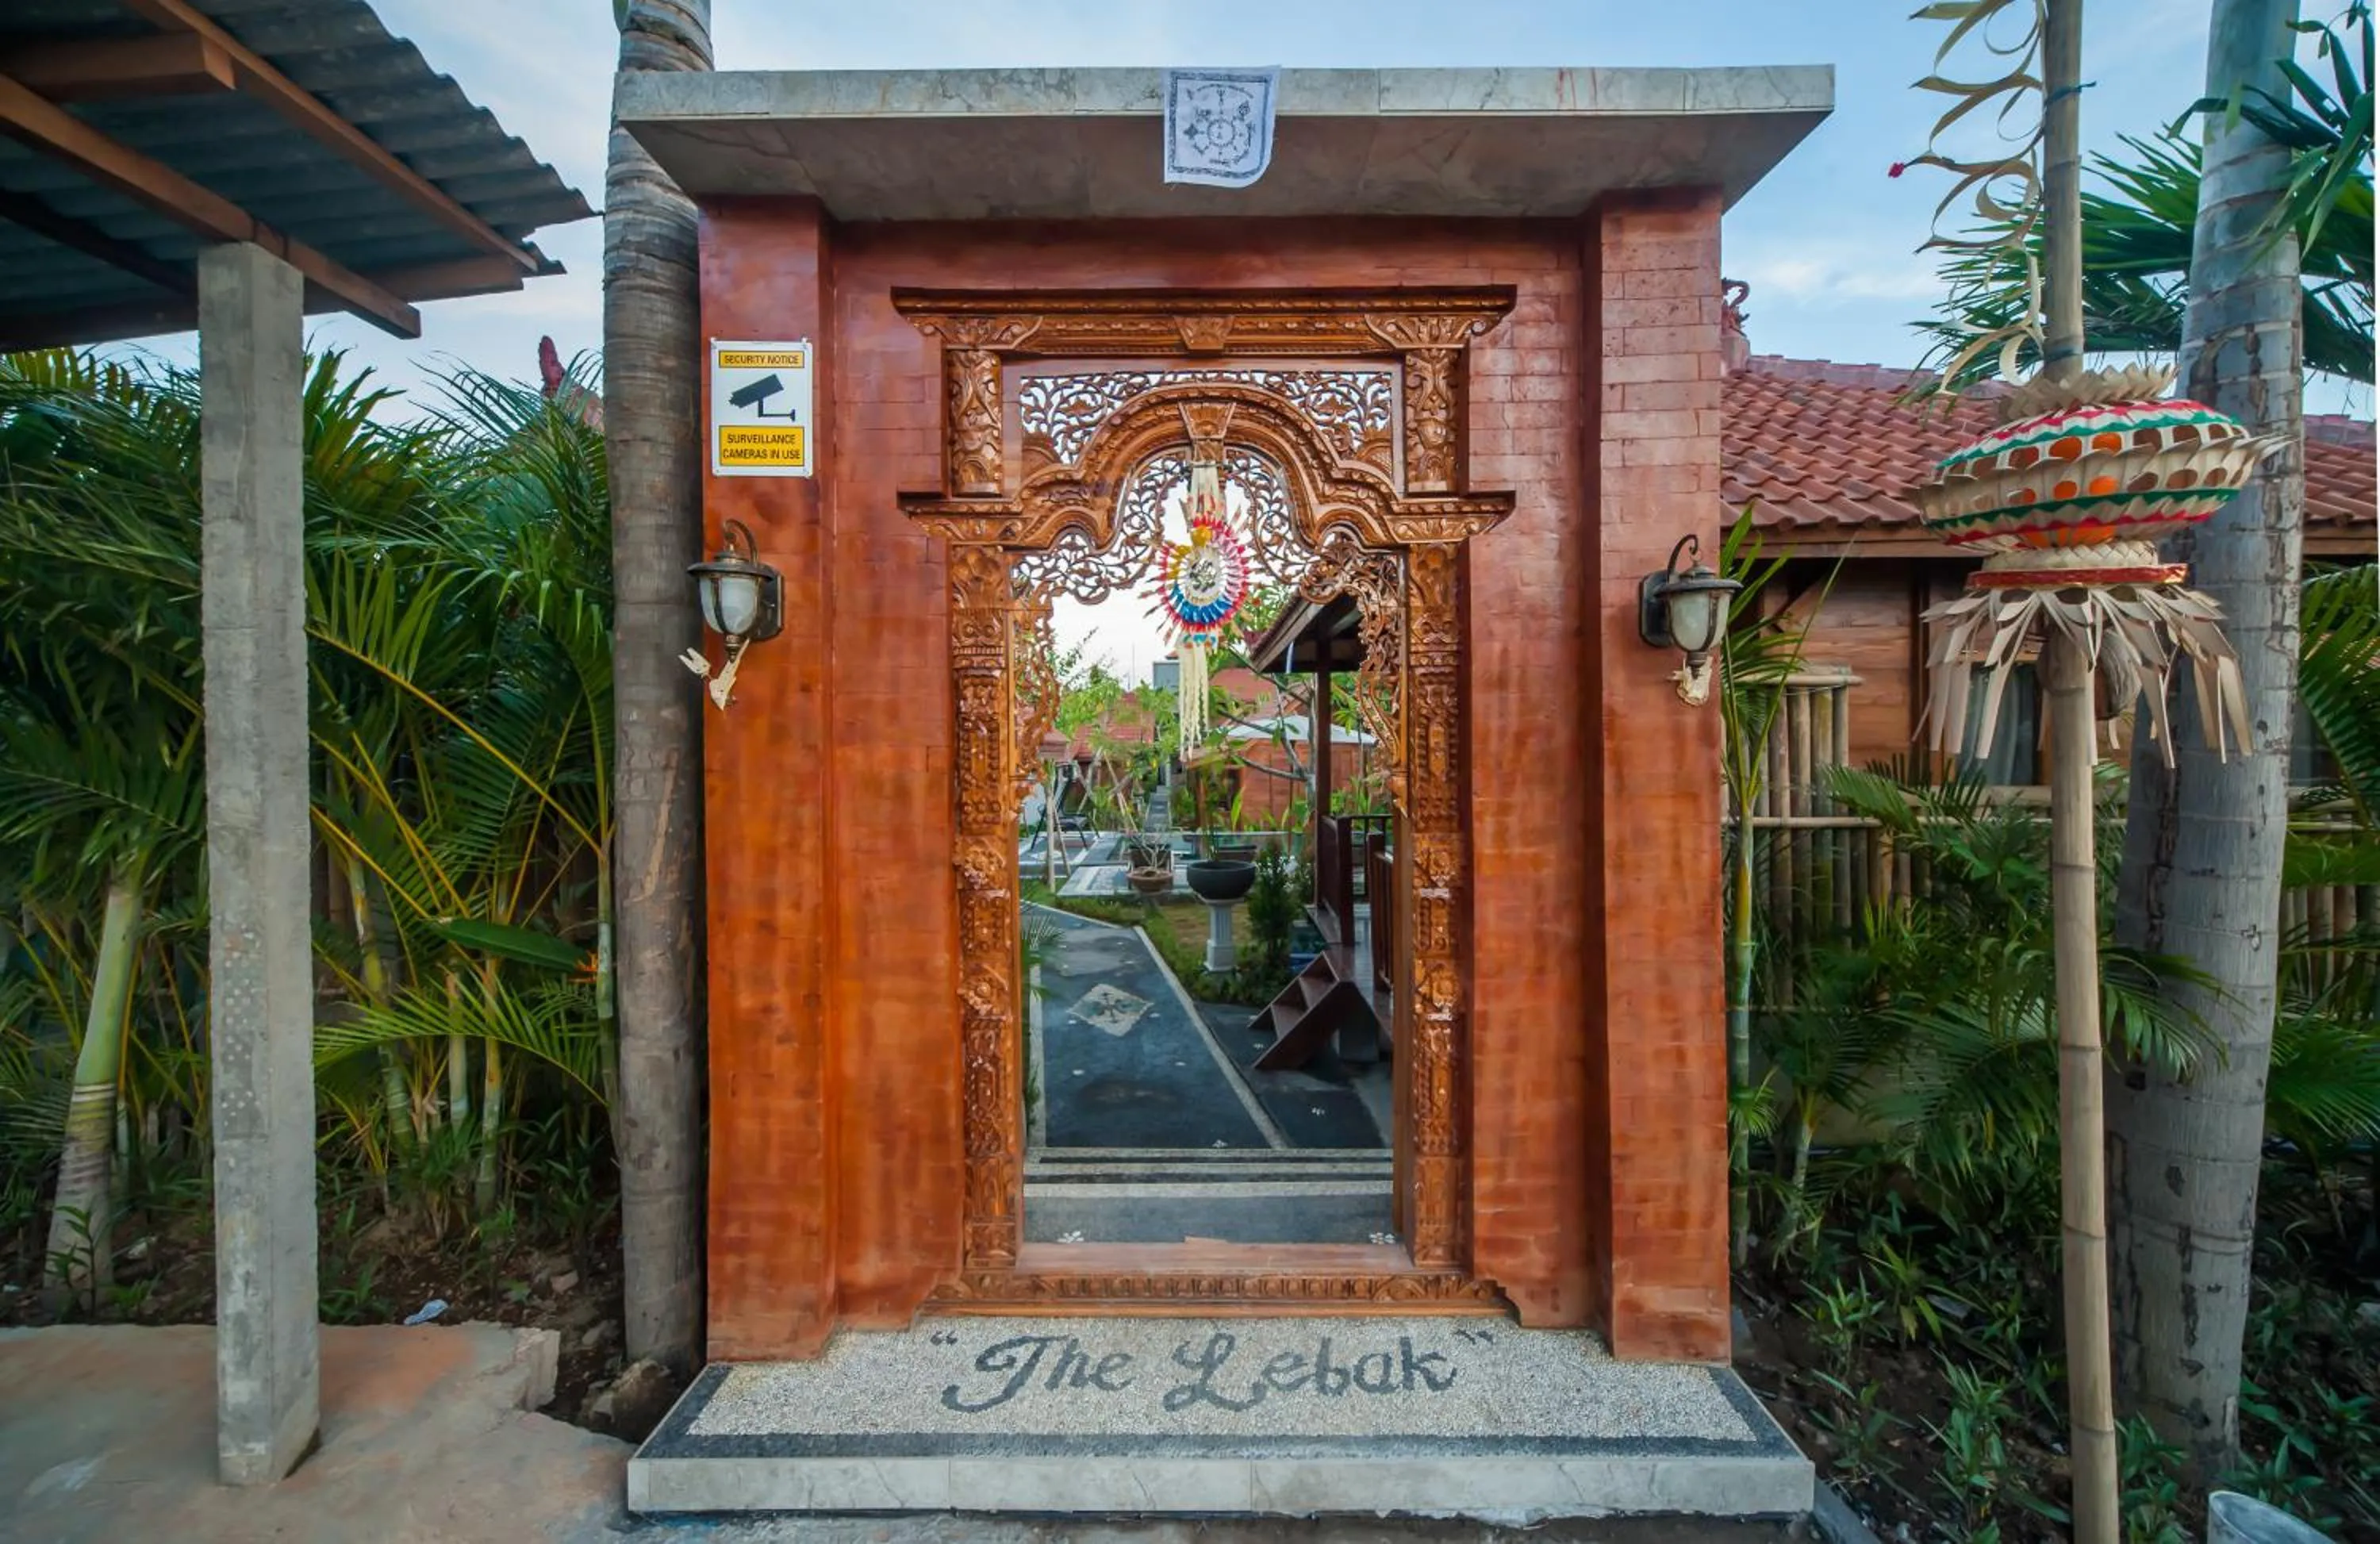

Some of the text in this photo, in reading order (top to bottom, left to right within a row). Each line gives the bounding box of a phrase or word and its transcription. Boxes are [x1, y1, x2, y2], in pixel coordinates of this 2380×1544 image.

[724, 355, 799, 364] SECURITY NOTICE
[727, 433, 796, 444] SURVEILLANCE
[723, 447, 800, 459] CAMERAS IN USE
